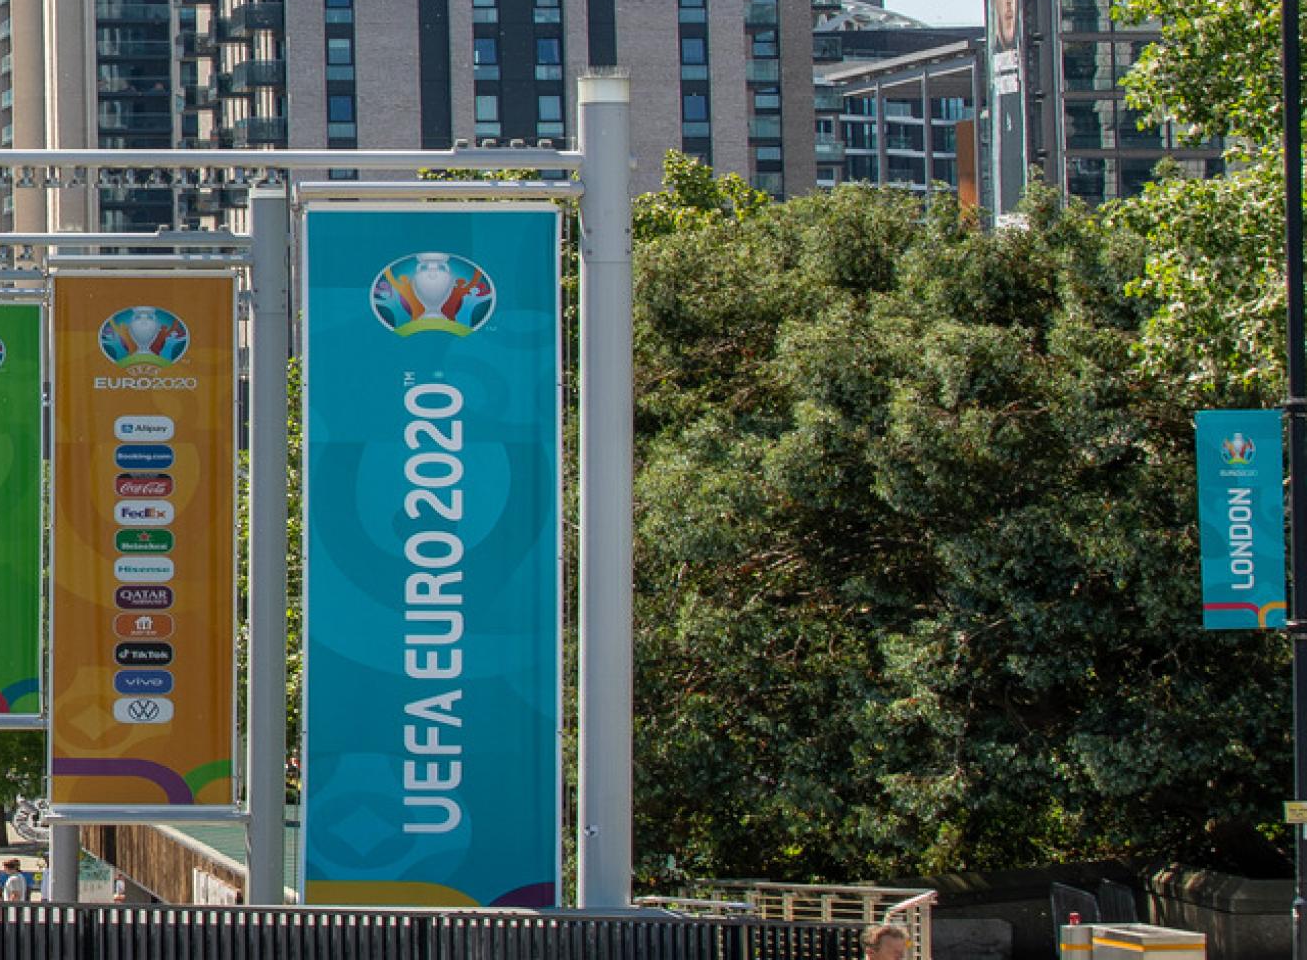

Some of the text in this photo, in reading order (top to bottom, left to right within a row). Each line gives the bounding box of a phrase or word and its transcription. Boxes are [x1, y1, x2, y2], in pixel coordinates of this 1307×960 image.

[122, 508, 166, 519] FedEx
[1227, 487, 1255, 589] LONDON
[120, 591, 167, 600] QATAR
[404, 530, 464, 680] EURO
[403, 689, 463, 834] UEFA
